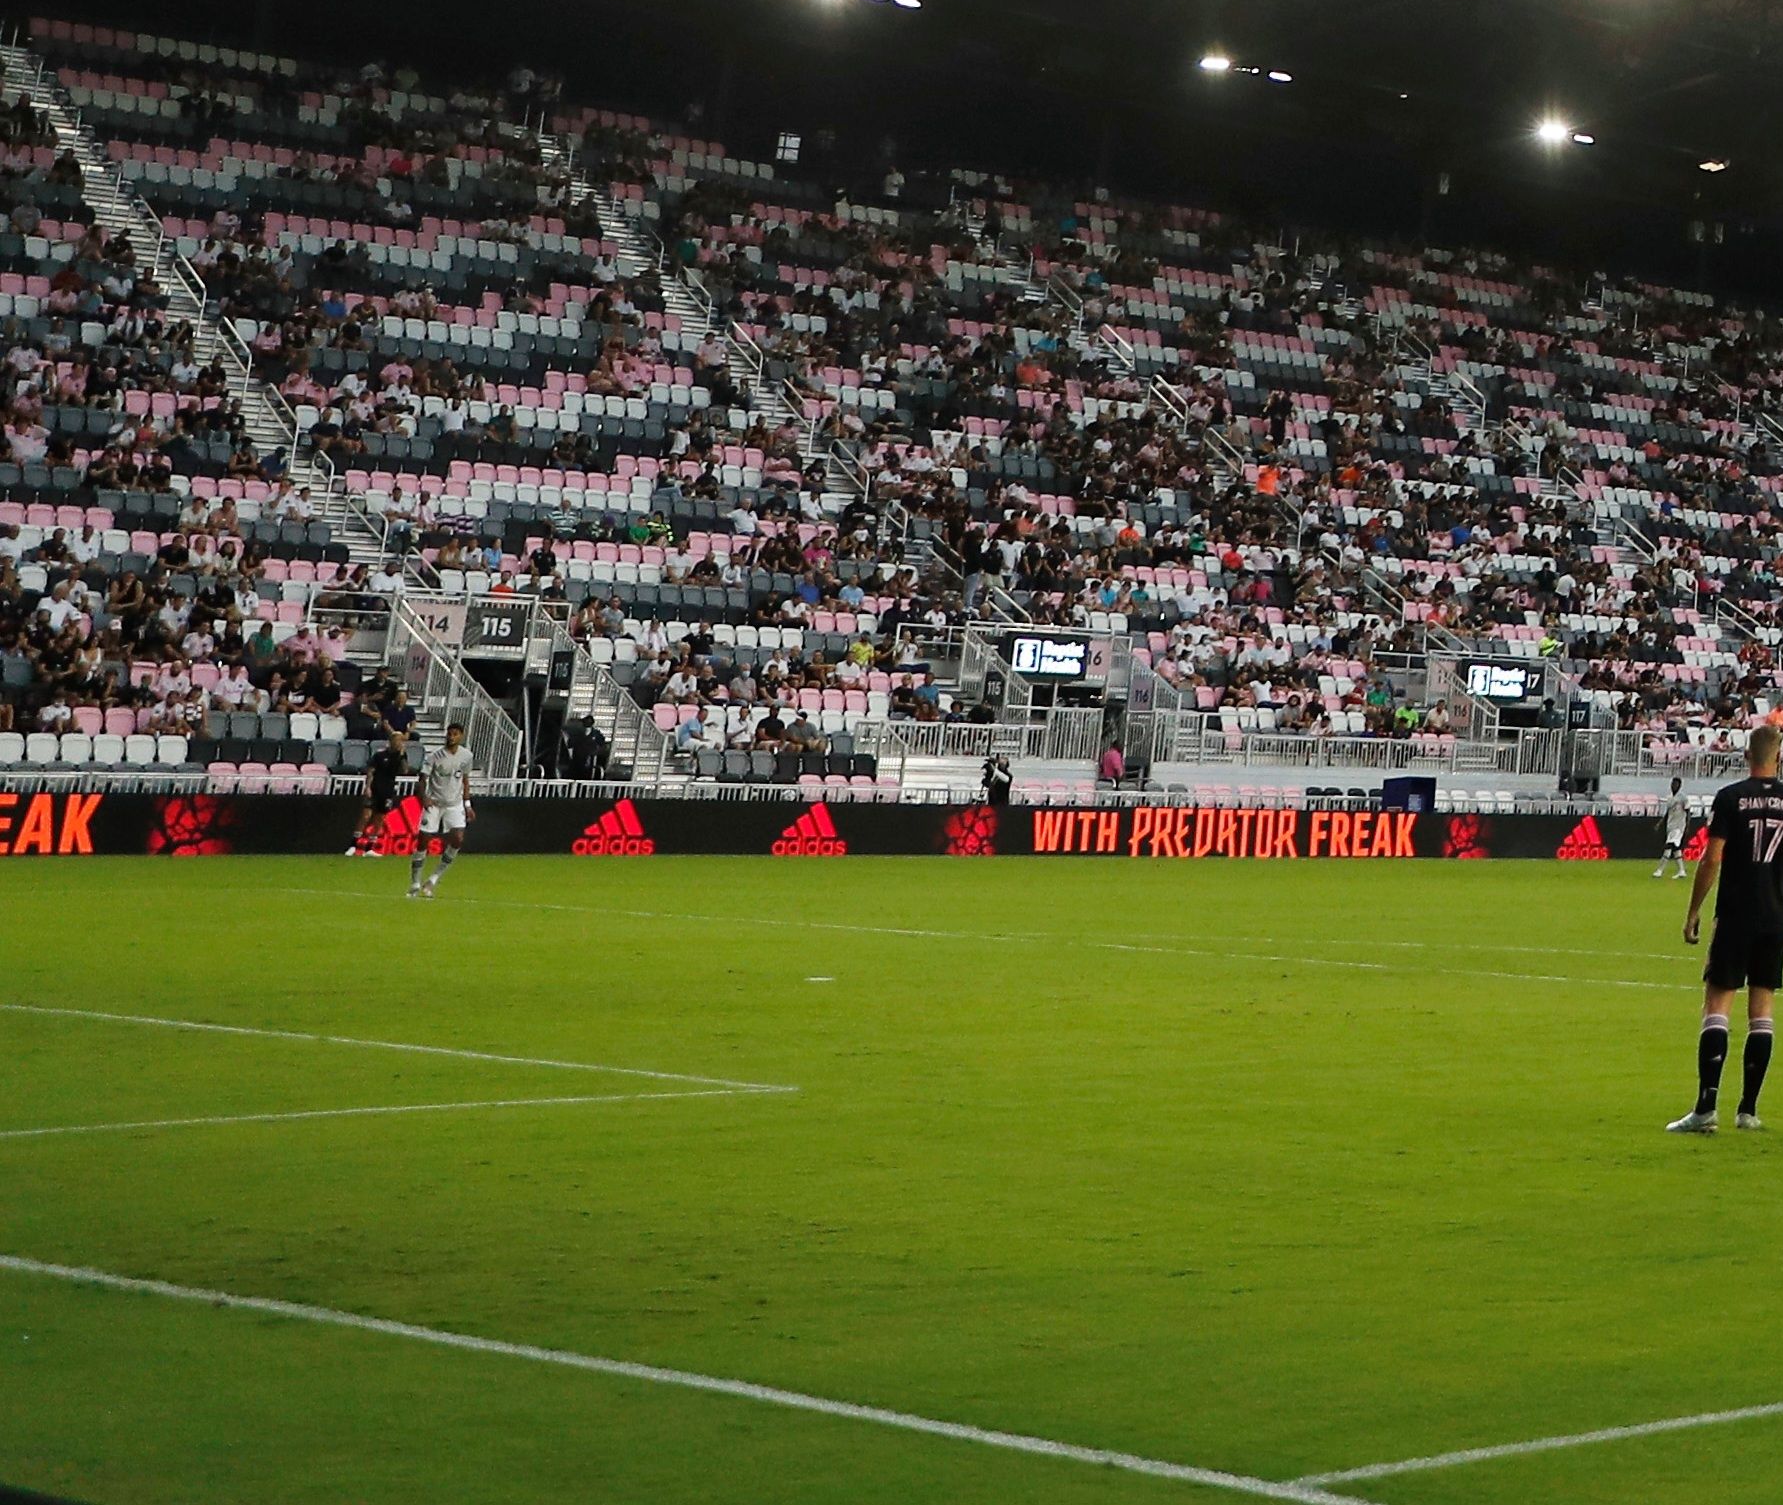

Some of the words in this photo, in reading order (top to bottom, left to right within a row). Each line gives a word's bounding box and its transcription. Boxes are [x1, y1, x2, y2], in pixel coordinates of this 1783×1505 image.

[481, 616, 512, 637] 115
[1134, 689, 1149, 703] 116
[1572, 710, 1586, 722] 117
[1033, 810, 1119, 852] WITH
[1128, 807, 1298, 858] PREDATOR
[1309, 811, 1417, 857] FREAK
[572, 837, 656, 856] adidas
[771, 837, 848, 856] adidas
[1556, 846, 1609, 860] adidas
